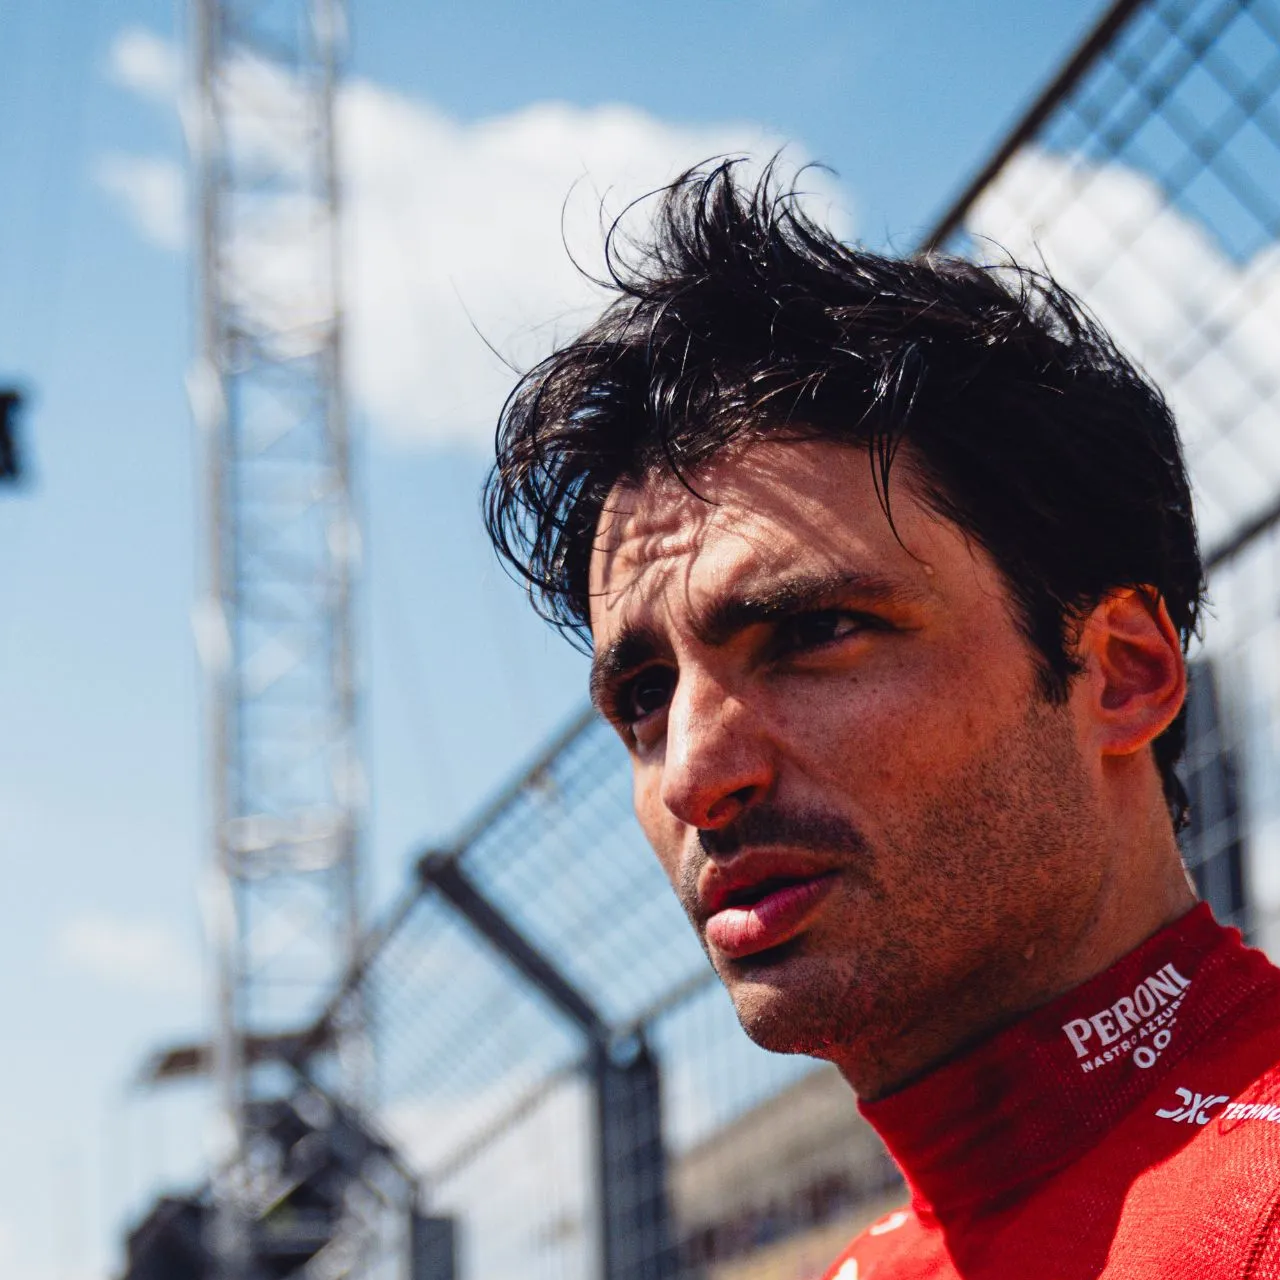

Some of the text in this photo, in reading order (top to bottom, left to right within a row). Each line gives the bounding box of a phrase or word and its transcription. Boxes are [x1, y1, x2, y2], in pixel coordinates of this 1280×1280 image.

[1062, 962, 1192, 1058] PERONI
[1139, 984, 1190, 1039] AZZUR
[1081, 1035, 1137, 1073] NASTRO
